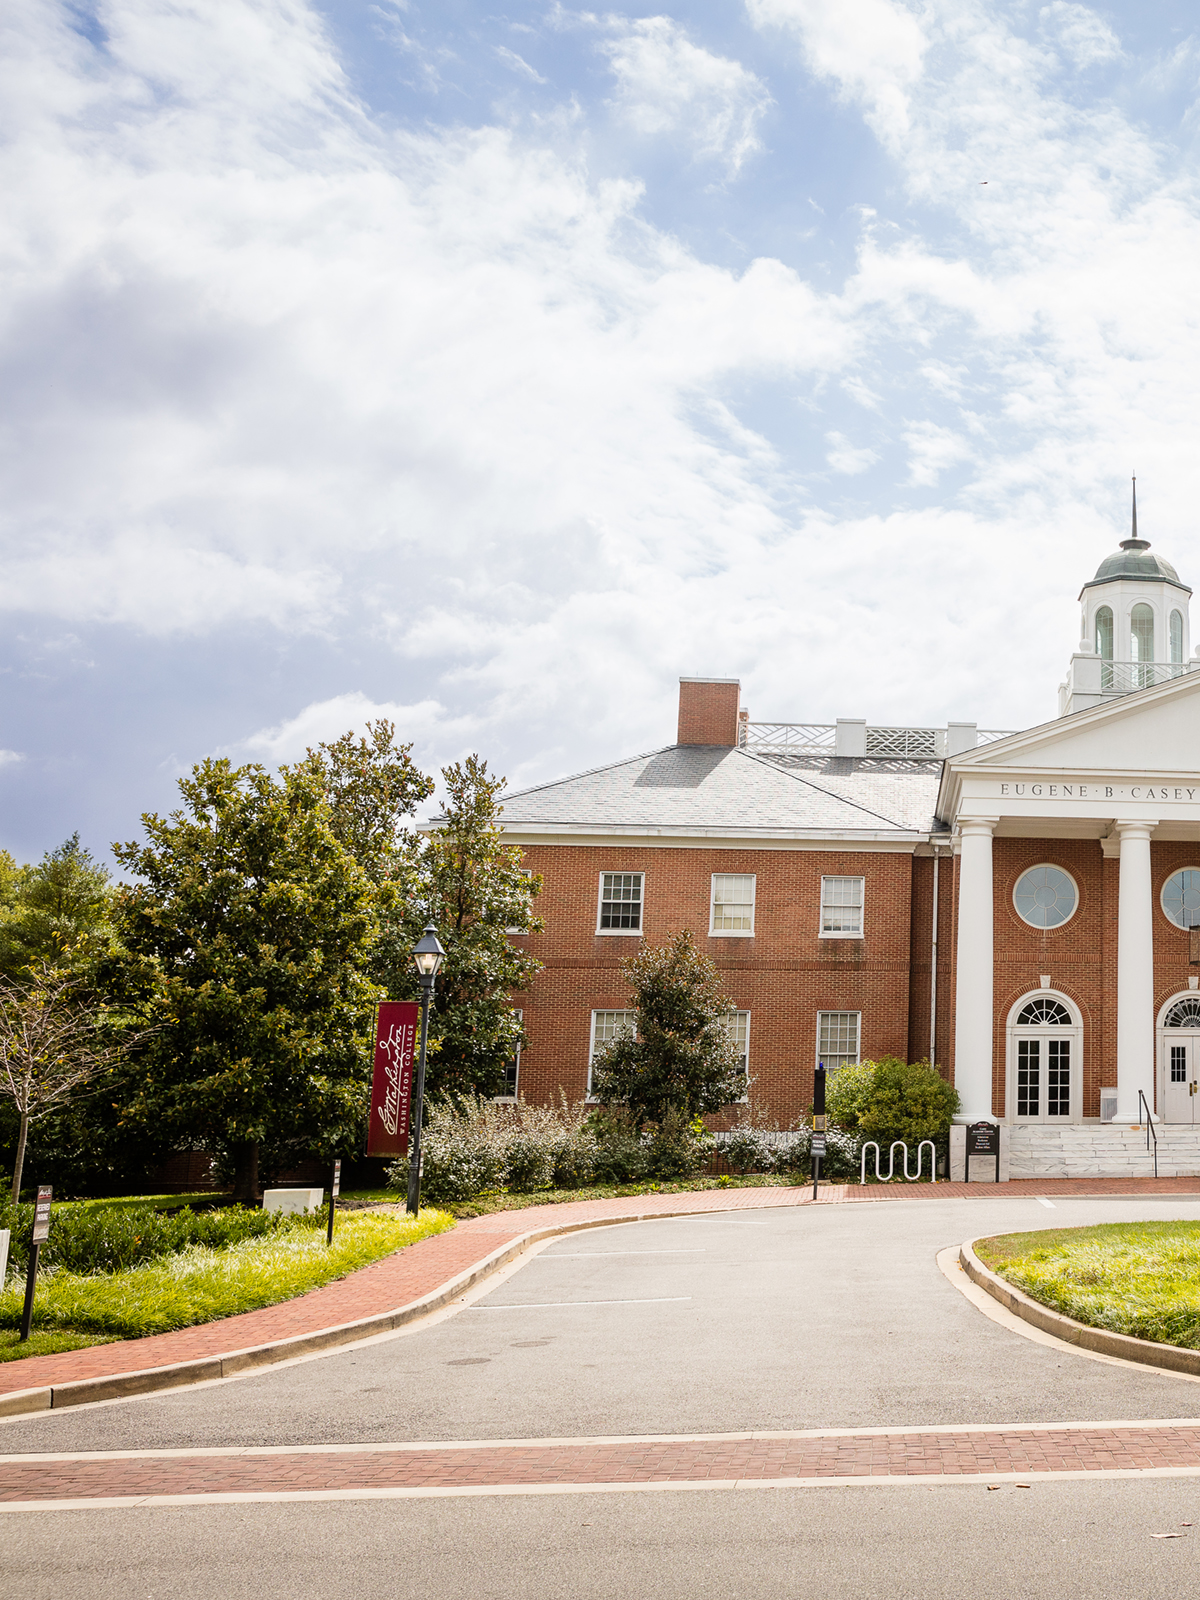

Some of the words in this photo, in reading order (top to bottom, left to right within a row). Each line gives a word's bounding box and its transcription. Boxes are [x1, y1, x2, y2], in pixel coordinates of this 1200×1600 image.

[1000, 783, 1088, 797] EUGENE
[1105, 786, 1113, 798] B
[1131, 787, 1196, 800] CASEY
[399, 1072, 410, 1135] WASHINGTON
[405, 1024, 414, 1066] COLLEGE
